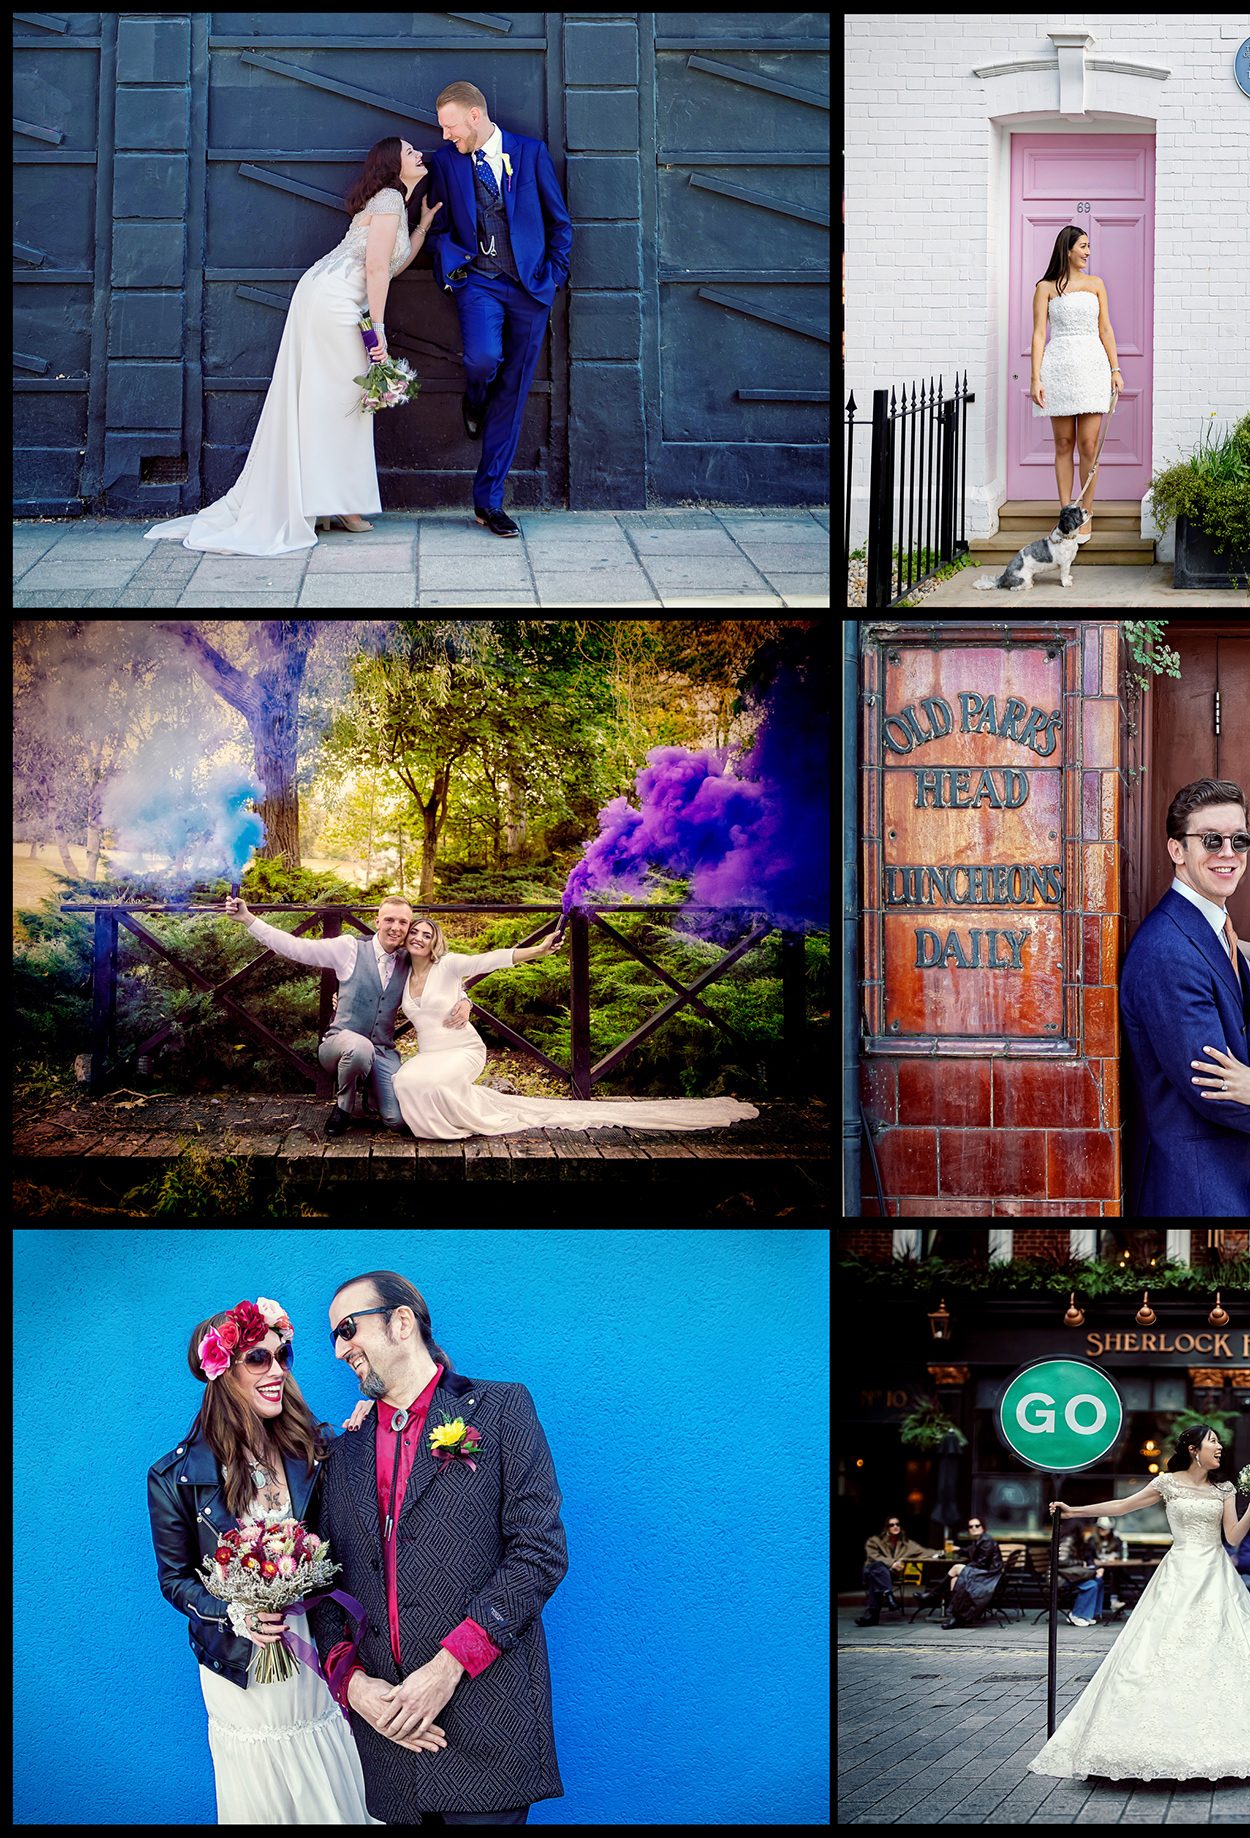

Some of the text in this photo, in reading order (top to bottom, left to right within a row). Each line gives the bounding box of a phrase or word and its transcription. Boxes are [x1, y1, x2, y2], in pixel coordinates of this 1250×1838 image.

[1077, 202, 1091, 213] 69
[883, 691, 1063, 757] OLD PARR'S
[914, 768, 1029, 809] HEAD
[884, 864, 1063, 906] LUNCHEONS
[914, 928, 1031, 969] DAILY
[1086, 1333, 1233, 1357] SHERLOCK
[1015, 1392, 1107, 1435] GO
